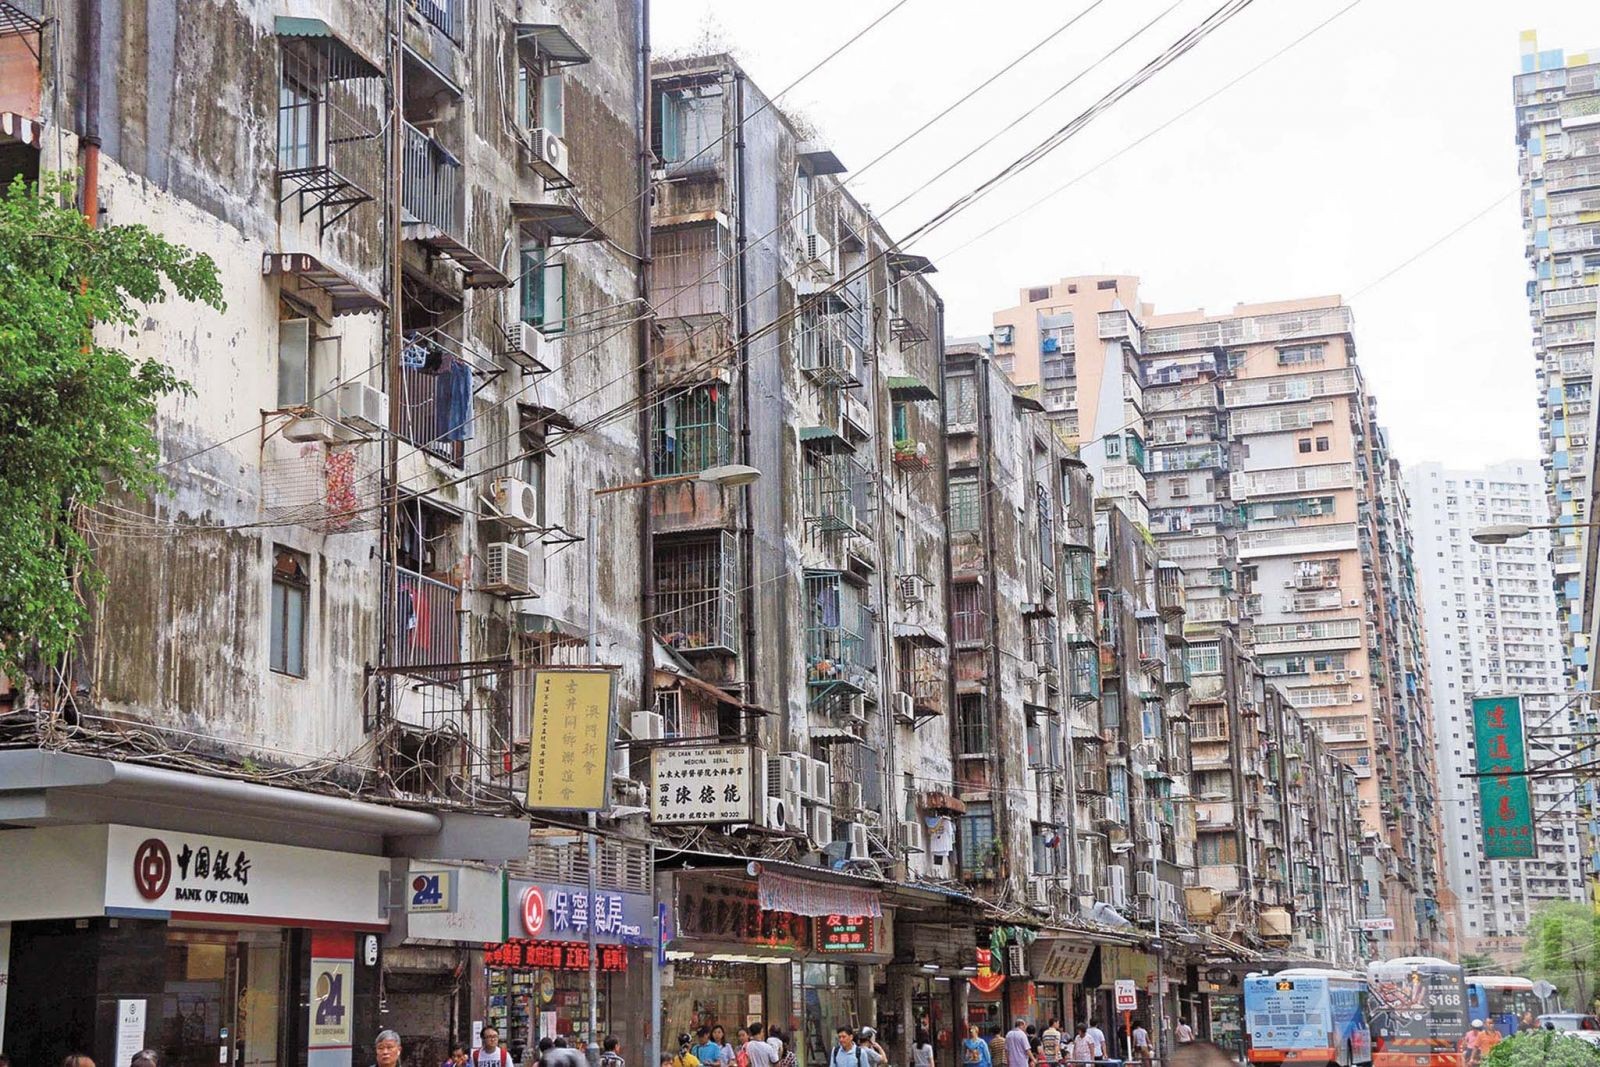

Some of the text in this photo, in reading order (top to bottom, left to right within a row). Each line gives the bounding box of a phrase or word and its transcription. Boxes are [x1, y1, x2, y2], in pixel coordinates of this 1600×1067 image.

[582, 704, 600, 776] 澳門新會
[175, 888, 249, 904] BANK OF CHINA
[413, 875, 442, 905] 24
[551, 889, 623, 935] 保寧藥房
[1118, 986, 1124, 994] 7
[1279, 982, 1290, 990] 22
[316, 972, 345, 1025] 24
[1429, 994, 1461, 1005] $168
